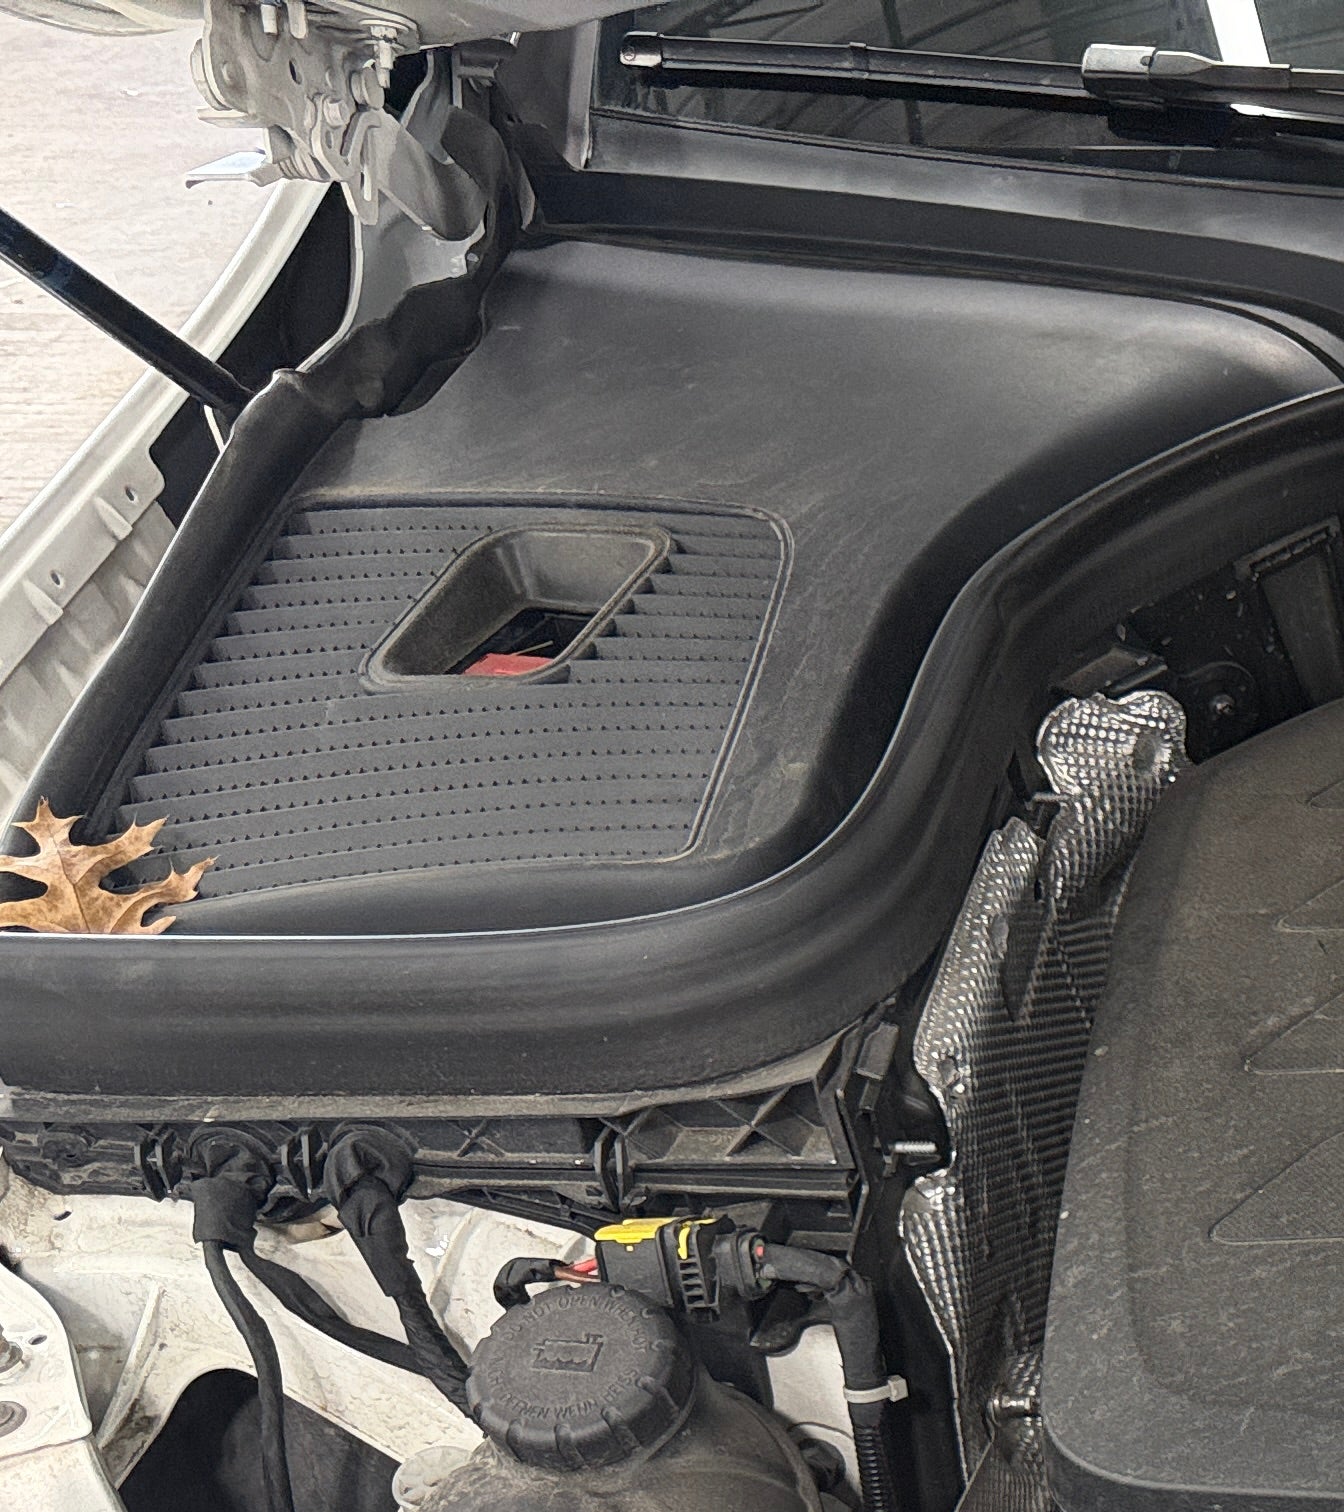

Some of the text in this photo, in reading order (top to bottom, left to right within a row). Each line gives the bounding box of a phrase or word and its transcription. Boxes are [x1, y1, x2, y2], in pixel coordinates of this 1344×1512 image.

[523, 1302, 553, 1324] NOT
[558, 1294, 599, 1310] OPEN
[554, 1399, 597, 1419] WENN
